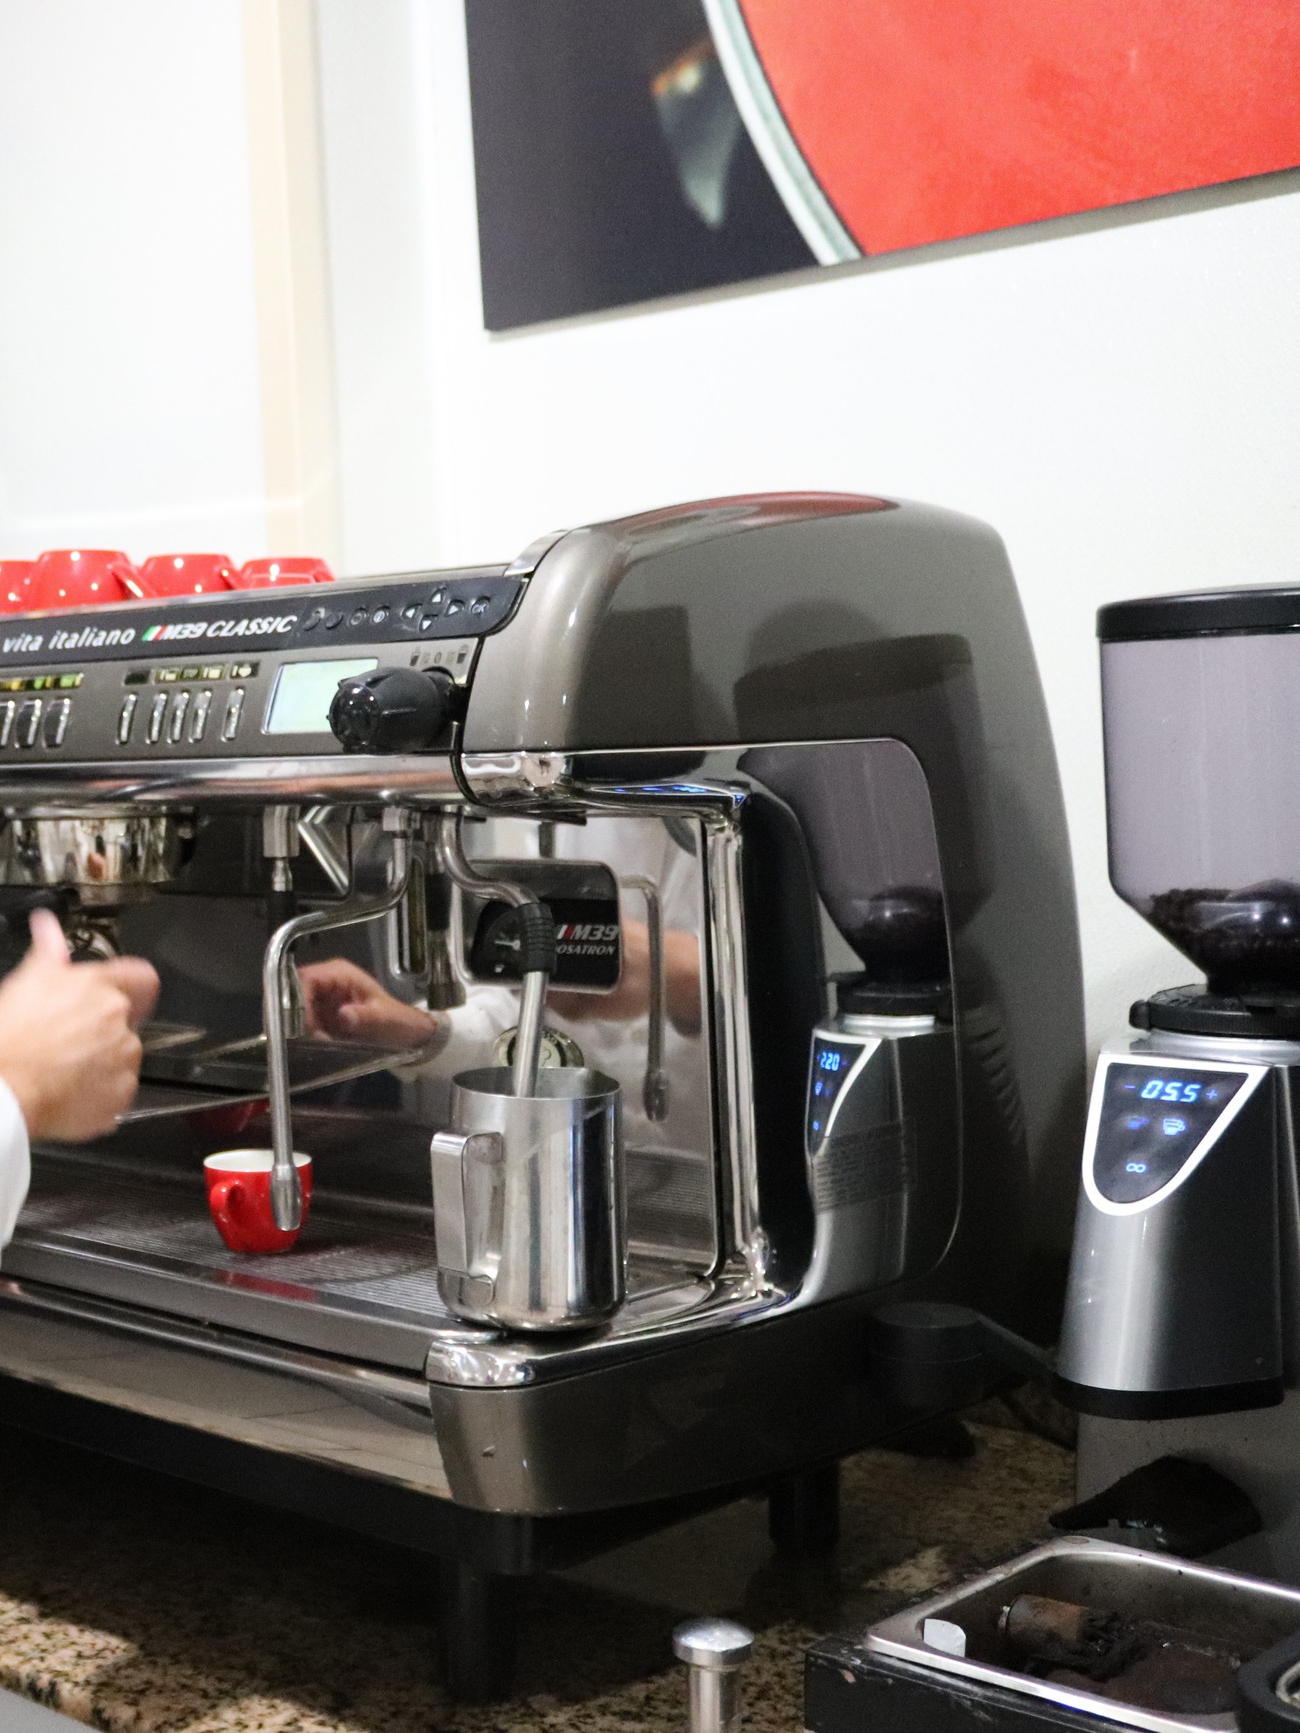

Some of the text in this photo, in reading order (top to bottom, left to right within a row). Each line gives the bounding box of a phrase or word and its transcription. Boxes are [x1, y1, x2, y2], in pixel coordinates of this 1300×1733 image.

[161, 615, 298, 640] M39 CLASSIC
[3, 632, 43, 653] vita
[48, 627, 136, 650] italiano
[569, 924, 619, 941] M39
[555, 943, 616, 956] OSATRON
